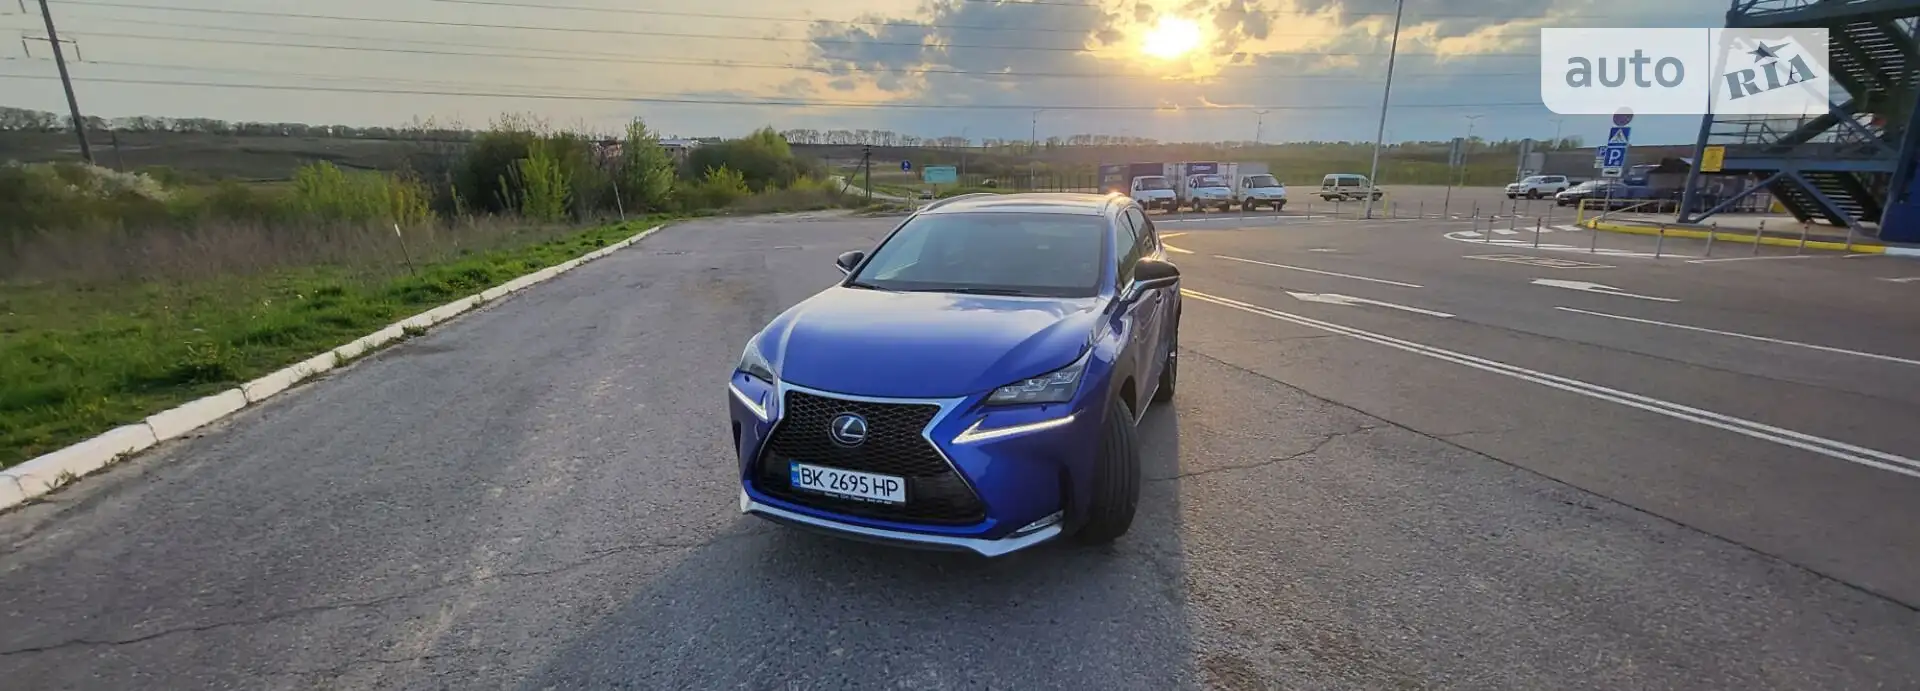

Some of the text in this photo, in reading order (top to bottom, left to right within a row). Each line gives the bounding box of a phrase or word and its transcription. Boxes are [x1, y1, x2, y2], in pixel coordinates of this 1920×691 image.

[1609, 149, 1621, 165] P
[801, 468, 898, 496] BK 2695 HP
